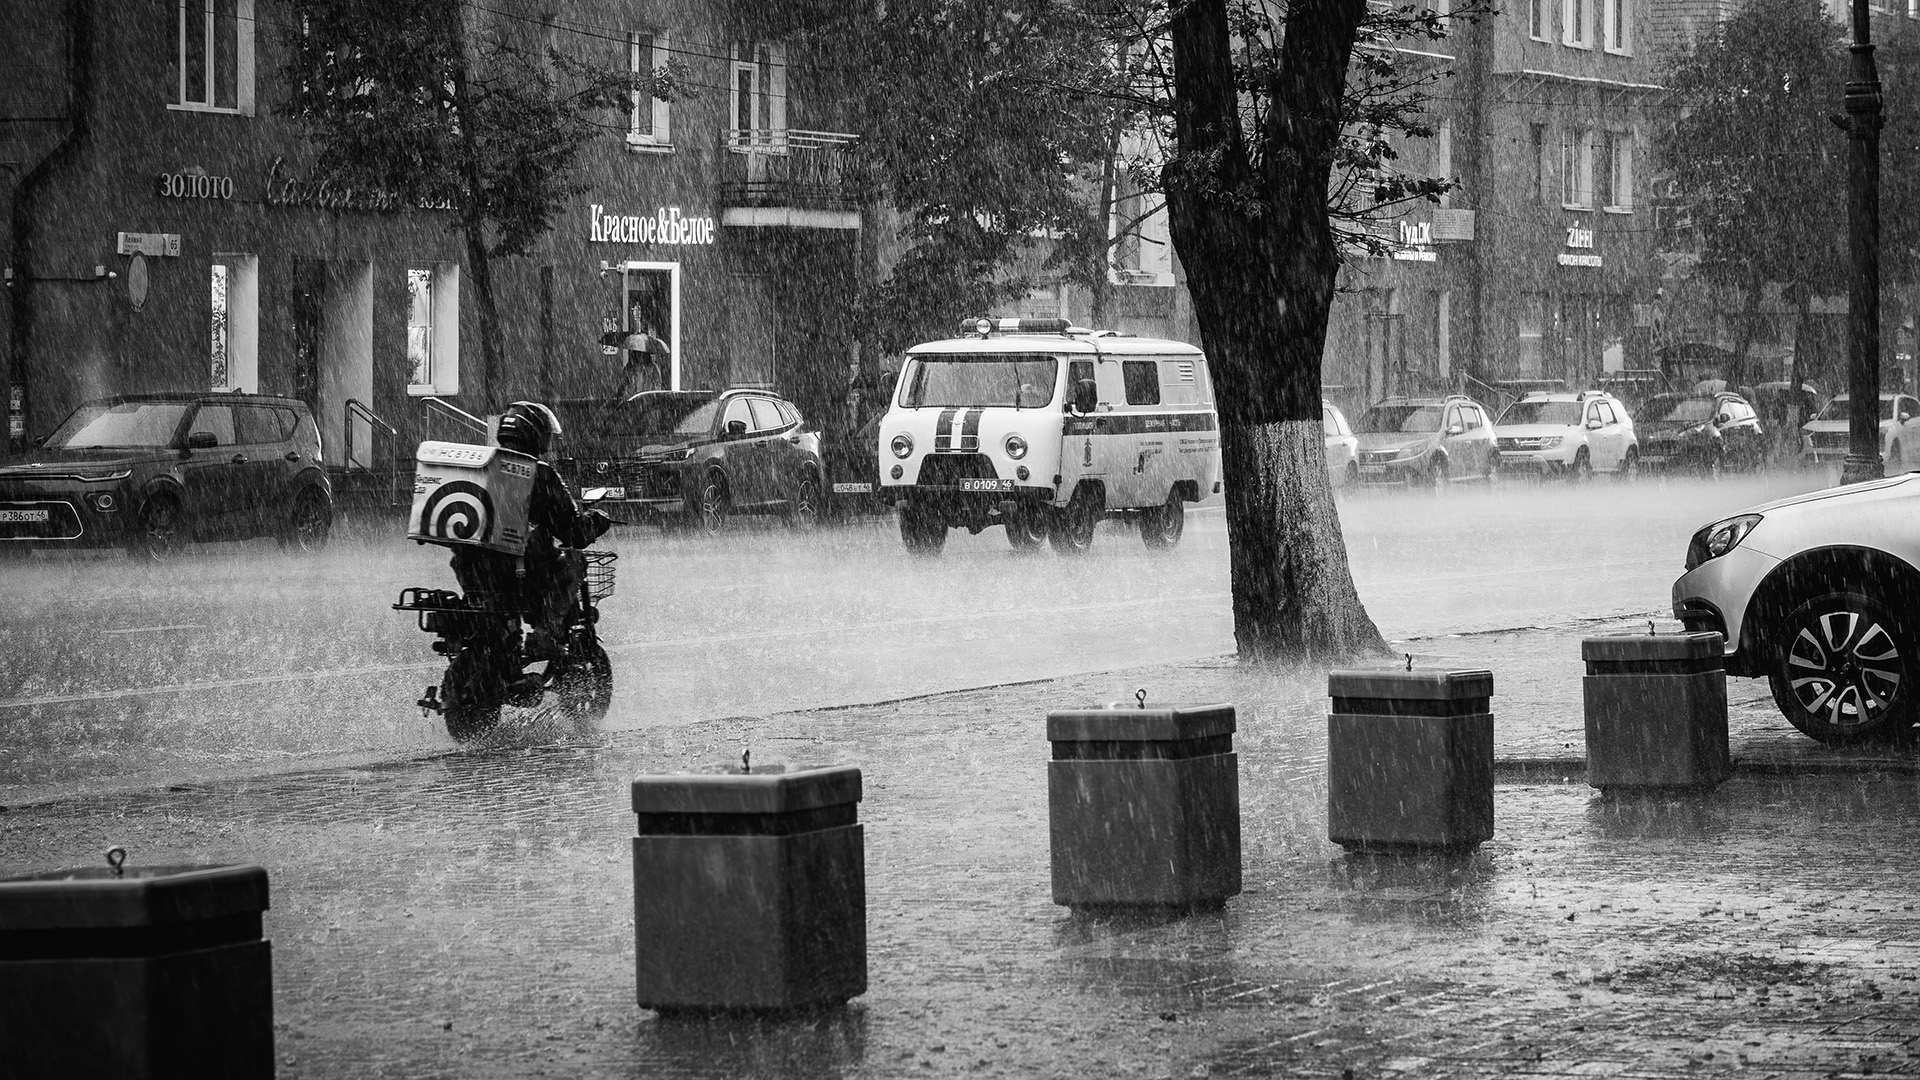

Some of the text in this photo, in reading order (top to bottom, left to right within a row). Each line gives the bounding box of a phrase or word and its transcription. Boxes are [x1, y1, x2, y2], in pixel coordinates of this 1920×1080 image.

[160, 172, 233, 199] ЗОЛОТО
[590, 204, 714, 245] Красное&Белое
[170, 239, 178, 250] 65
[973, 480, 998, 490] 0109
[1002, 479, 1012, 488] 46
[2, 511, 35, 521] Р386ОТ
